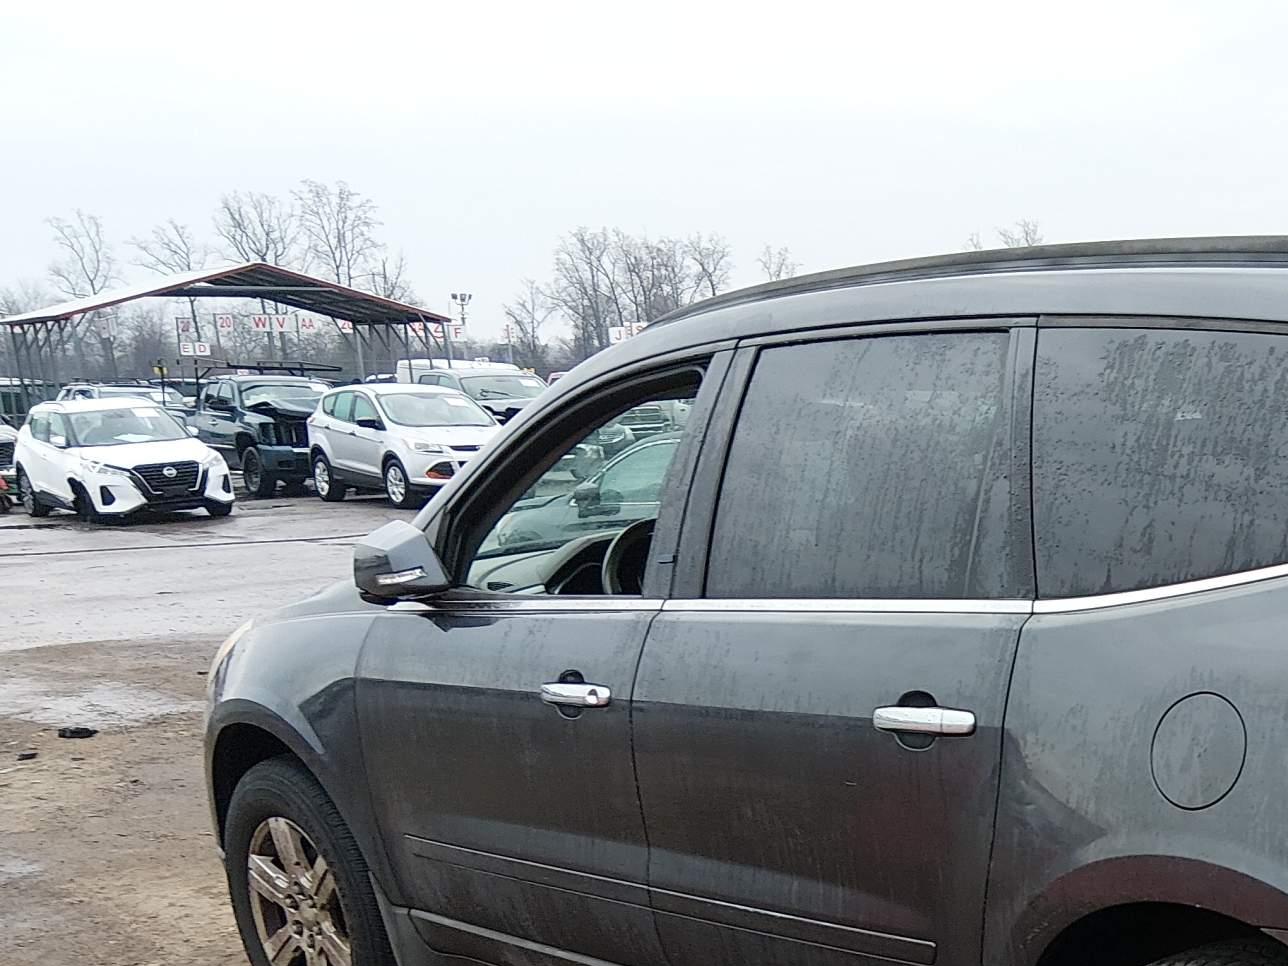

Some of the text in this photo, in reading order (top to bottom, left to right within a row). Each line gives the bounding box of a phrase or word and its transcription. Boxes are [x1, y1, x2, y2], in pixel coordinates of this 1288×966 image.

[219, 316, 231, 328] 20
[252, 317, 267, 328] W
[276, 317, 286, 328] V
[301, 318, 316, 329] AA
[454, 327, 462, 338] F
[182, 344, 190, 352] E
[199, 344, 207, 352] D
